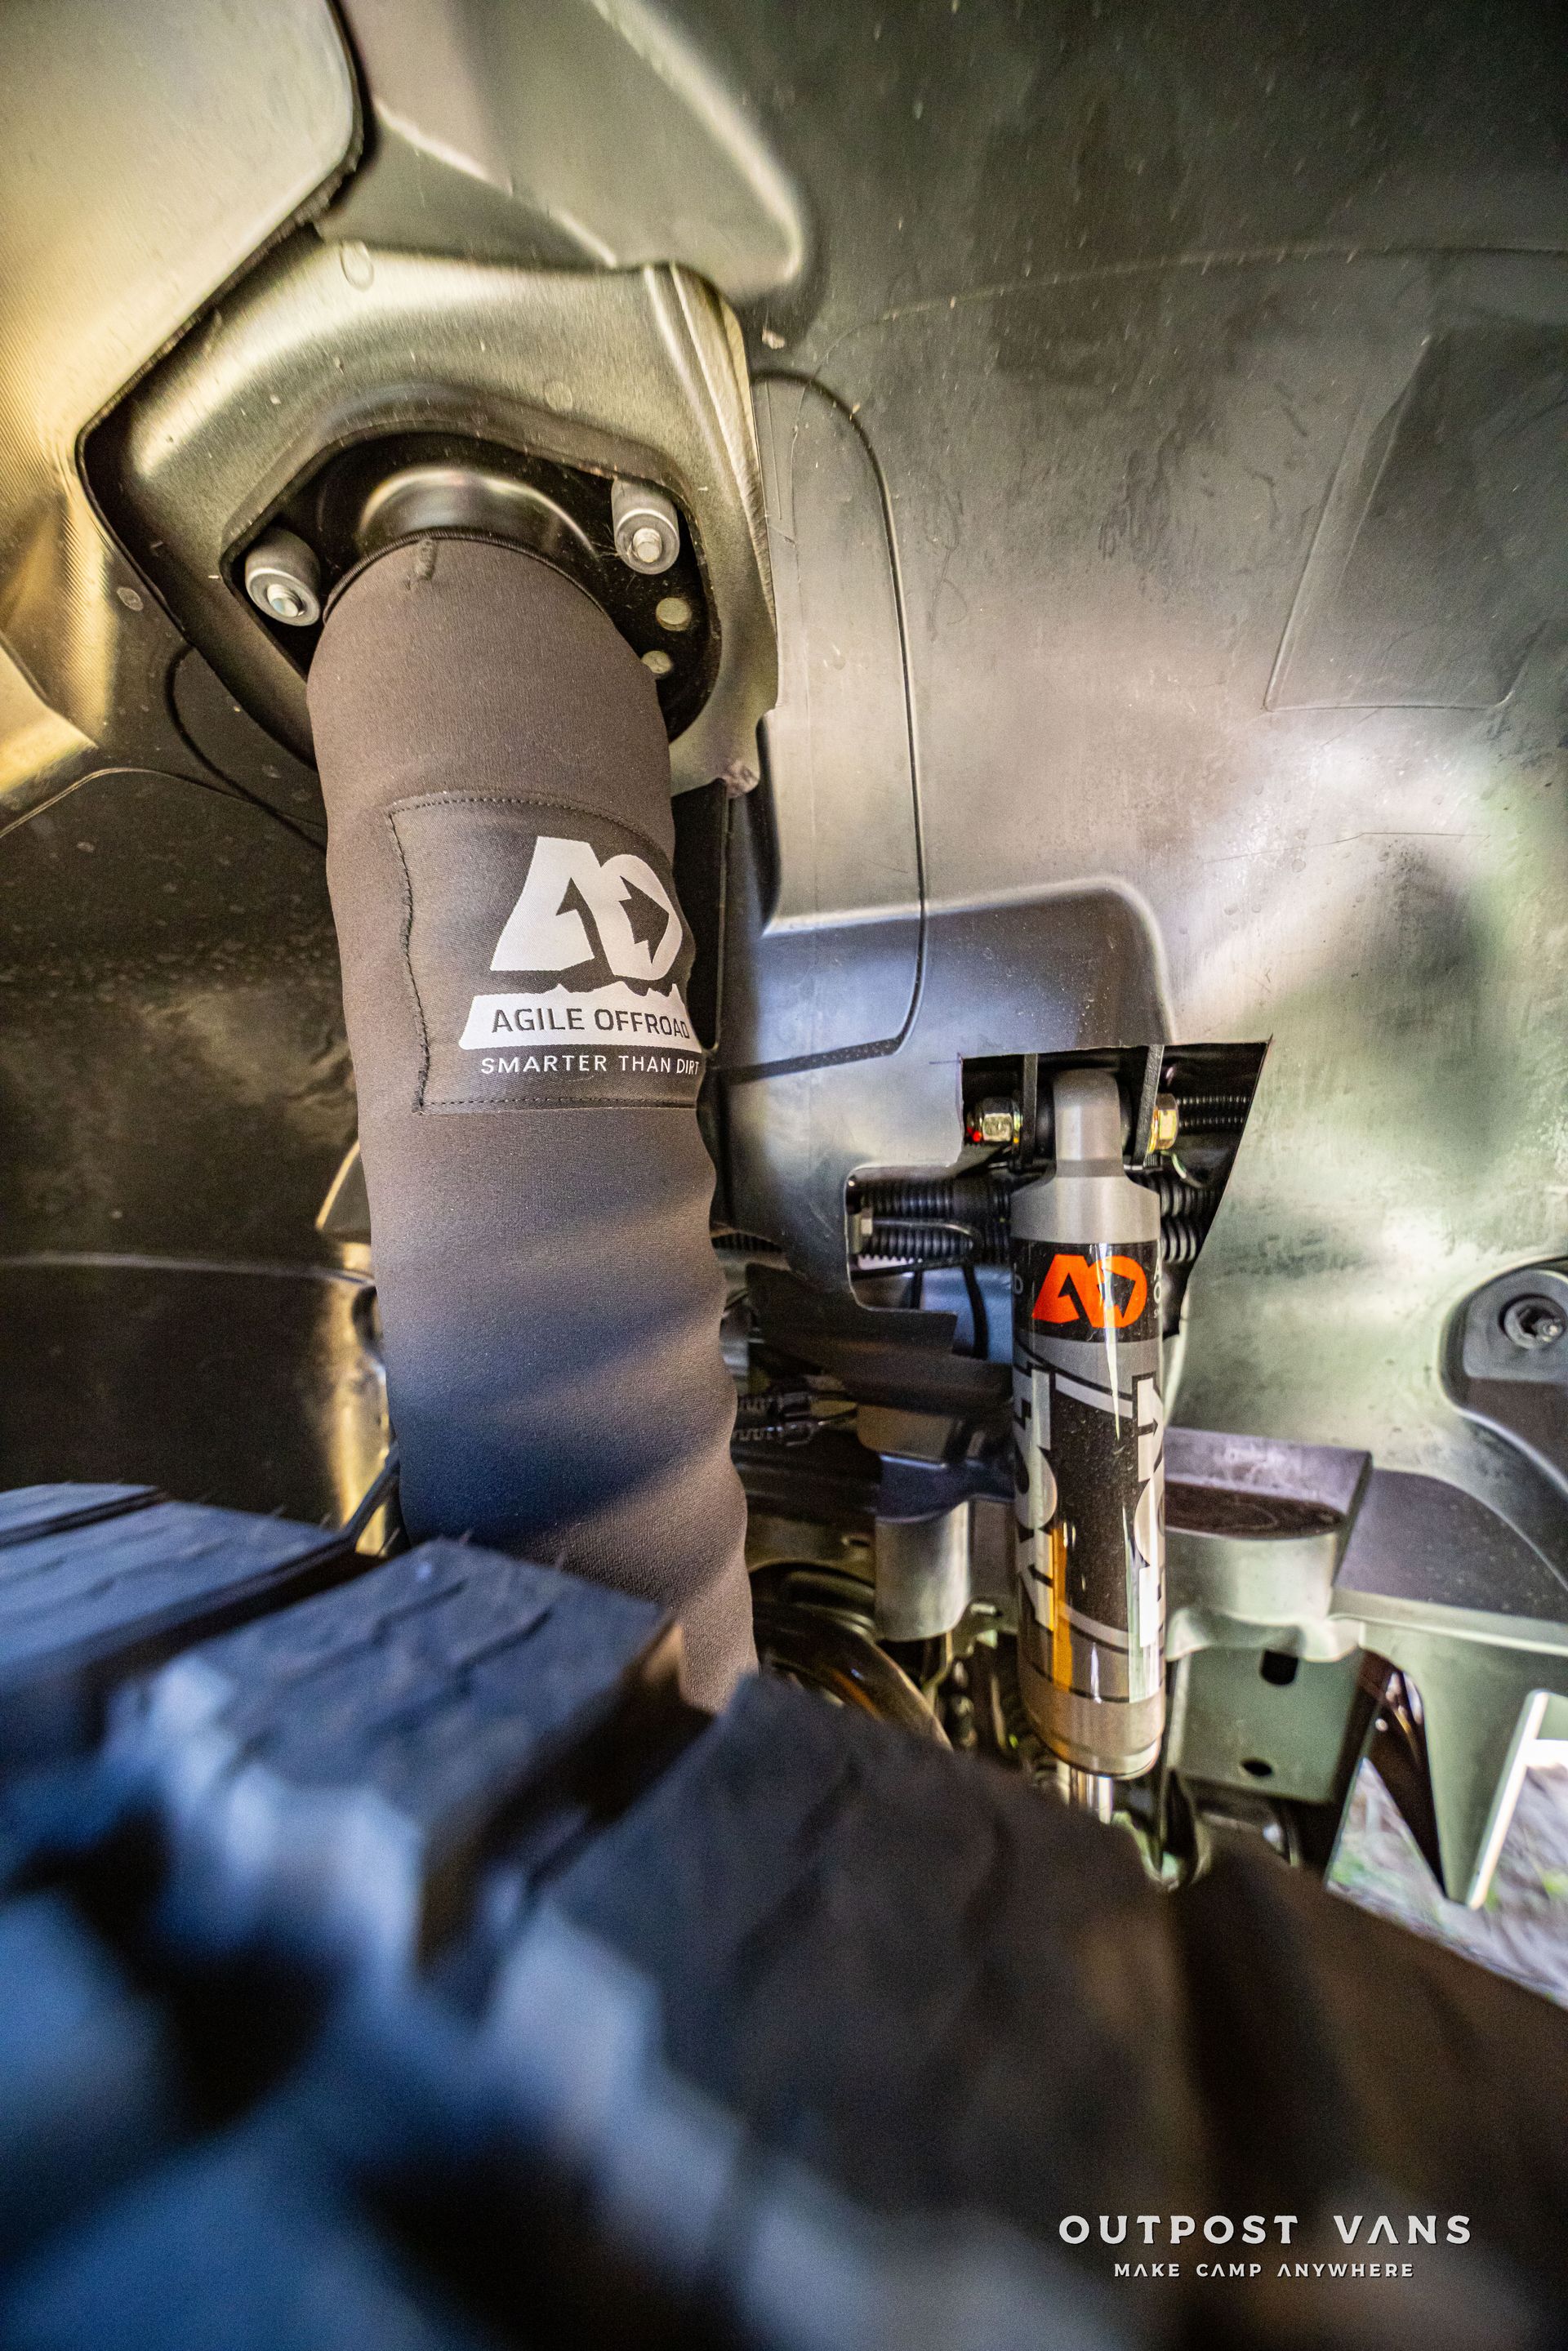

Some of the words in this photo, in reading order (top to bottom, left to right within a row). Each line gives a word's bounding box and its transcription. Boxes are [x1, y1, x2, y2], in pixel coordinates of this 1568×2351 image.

[492, 1007, 586, 1033] AGILE
[594, 1008, 691, 1040] OFFROAD
[480, 1054, 608, 1075] SMARTER
[617, 1054, 670, 1073] THAN
[675, 1058, 700, 1075] DIRT
